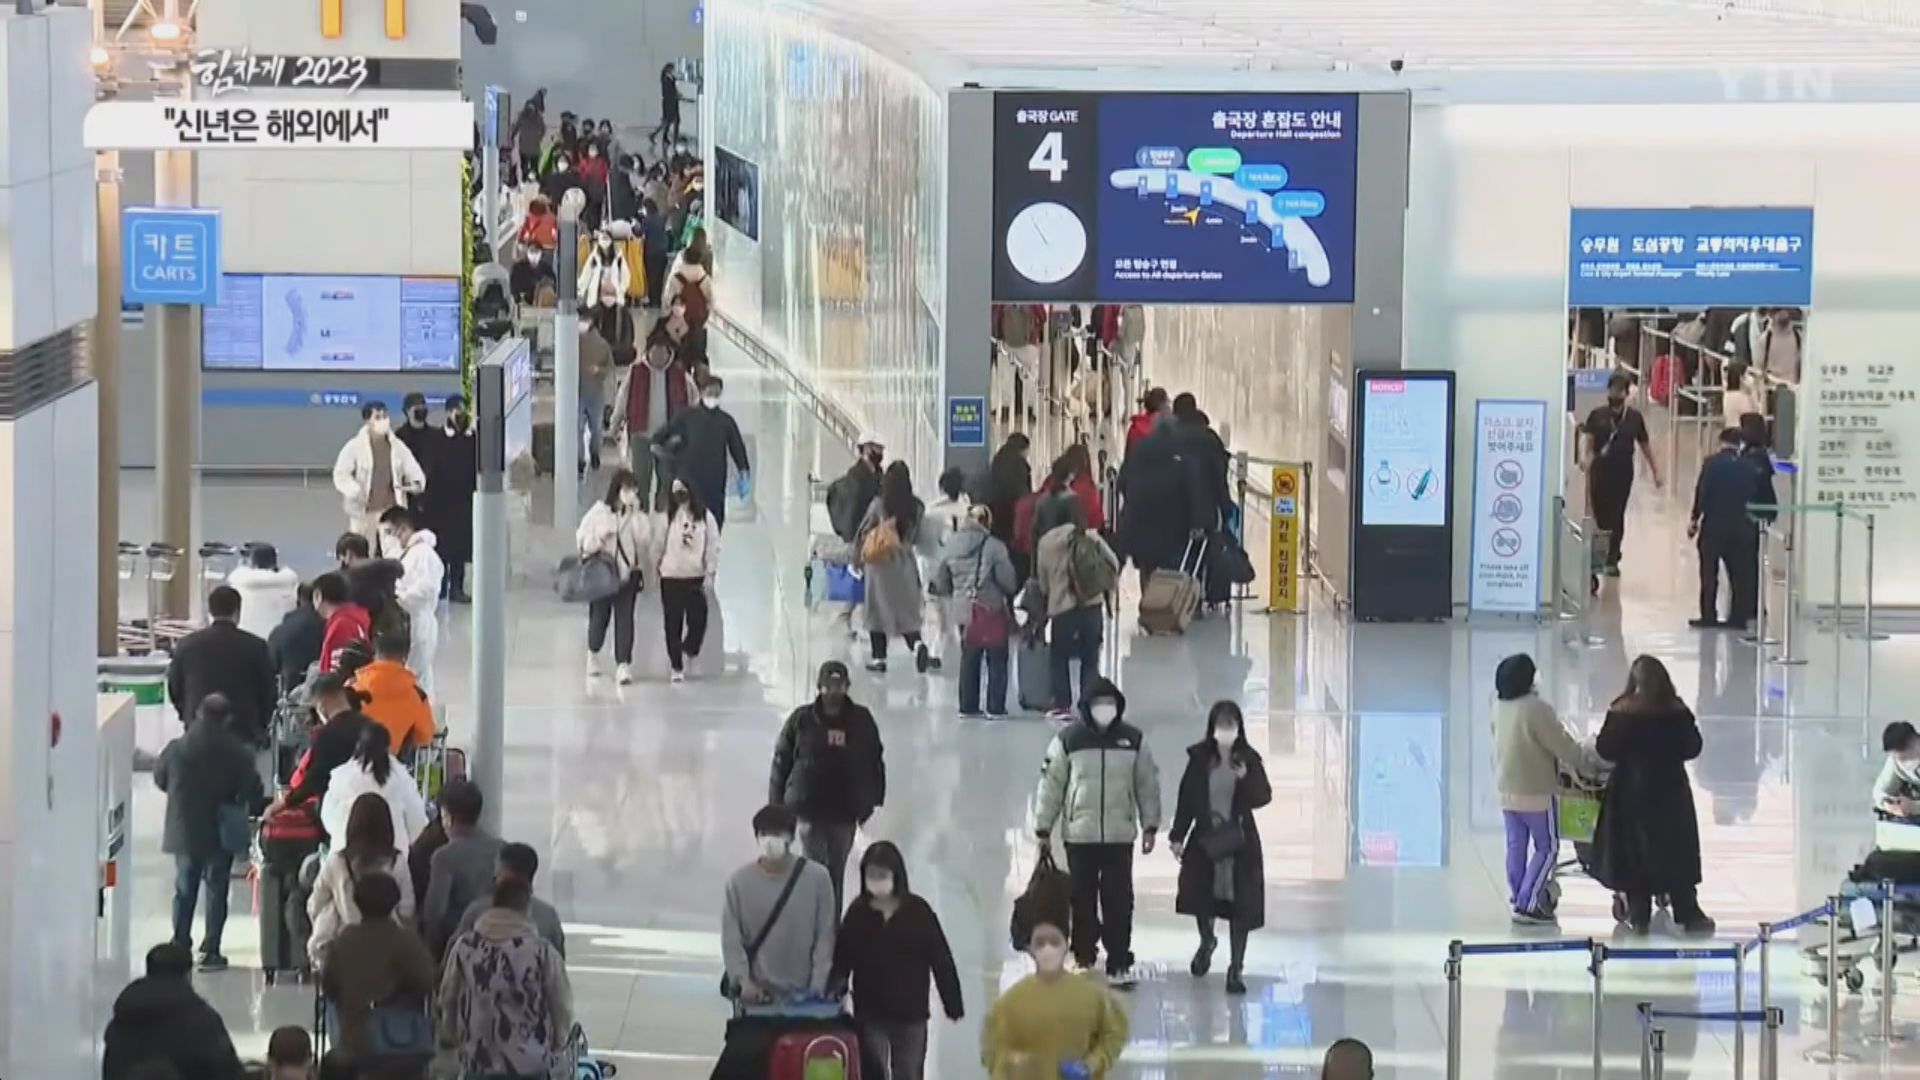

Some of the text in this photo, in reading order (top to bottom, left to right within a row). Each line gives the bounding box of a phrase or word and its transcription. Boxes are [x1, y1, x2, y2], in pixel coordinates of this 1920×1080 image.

[1016, 109, 1079, 123] 출국장 GATE
[1212, 110, 1341, 129] 출국장 혼잡도 안내
[1230, 130, 1341, 140] Departure Hall congestion
[1028, 131, 1069, 182] 4
[143, 233, 196, 261] 카트
[1580, 236, 1620, 254] 승무원
[1632, 236, 1685, 254] 도심공항
[143, 265, 196, 281] CARTS
[1114, 270, 1140, 280] Access
